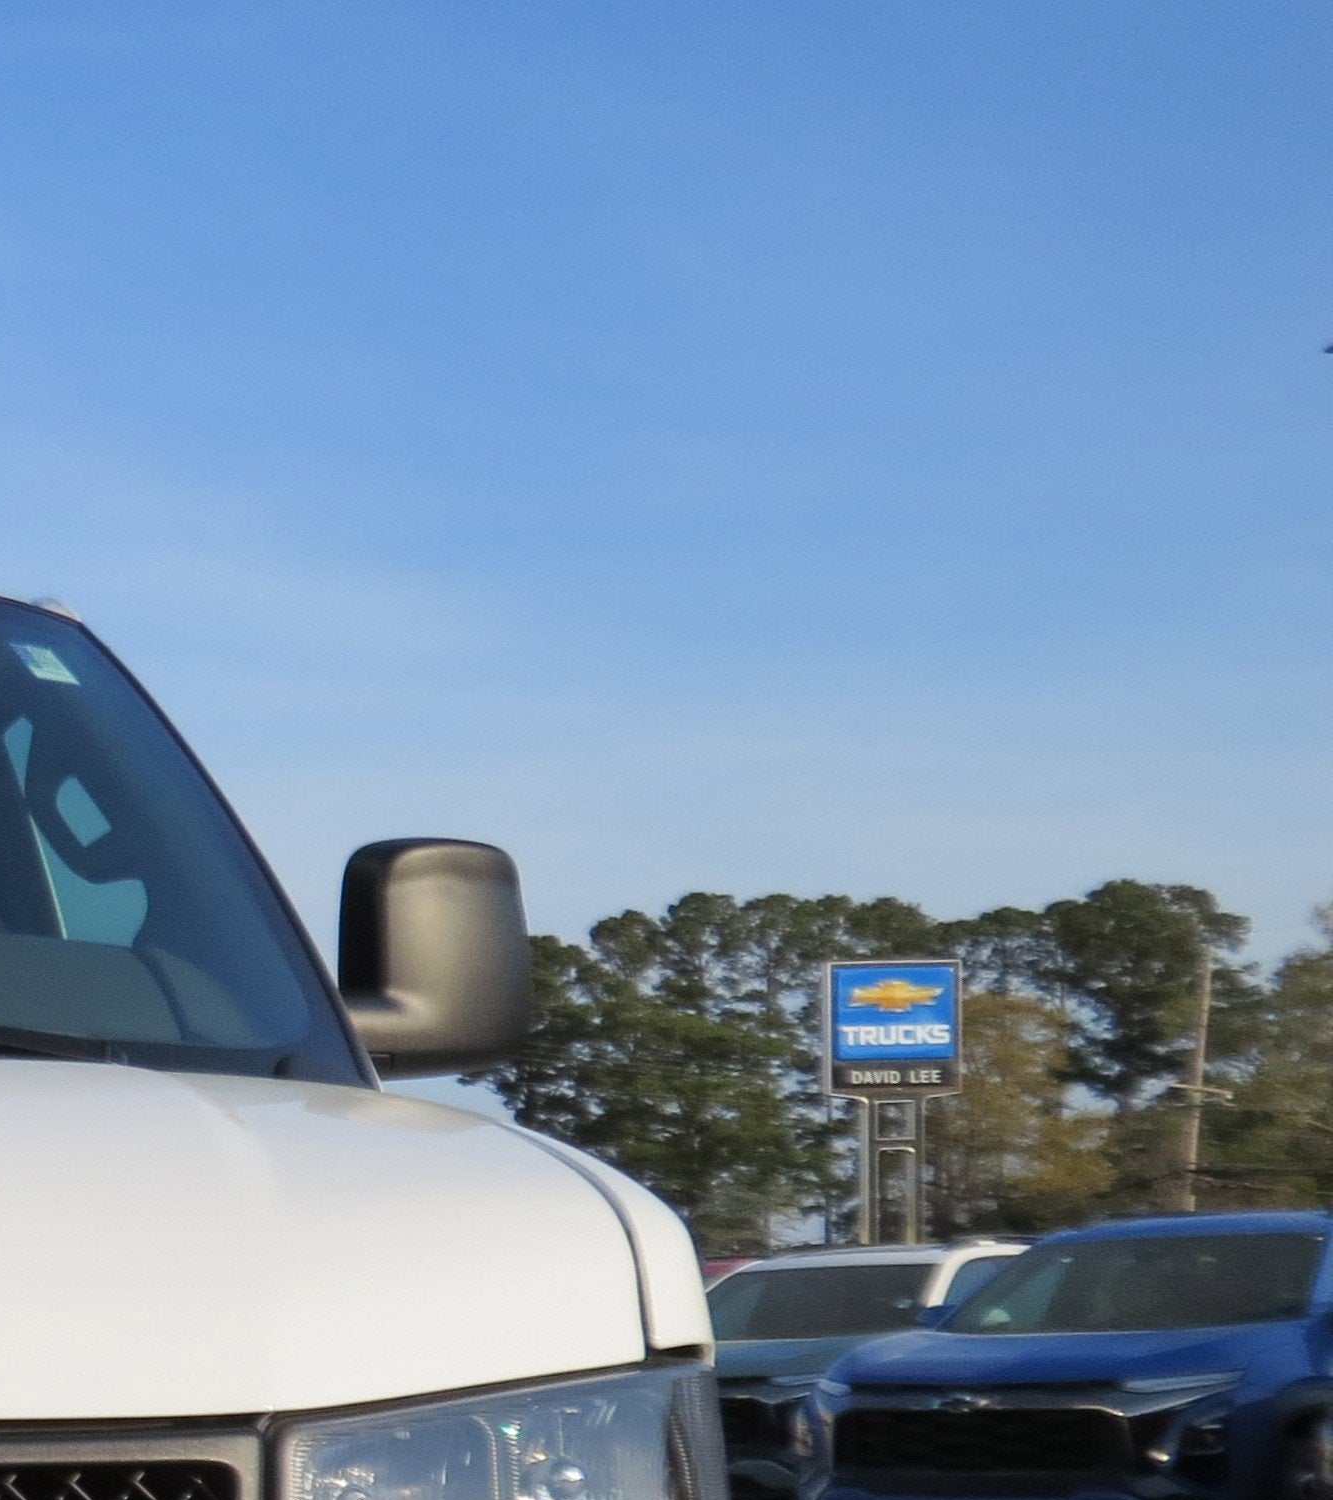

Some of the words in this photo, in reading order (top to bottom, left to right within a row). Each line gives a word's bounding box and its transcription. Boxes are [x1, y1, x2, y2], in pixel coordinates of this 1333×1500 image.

[839, 1023, 951, 1046] TRUCKS
[850, 1070, 902, 1085] DAVID
[910, 1069, 942, 1084] LEE
